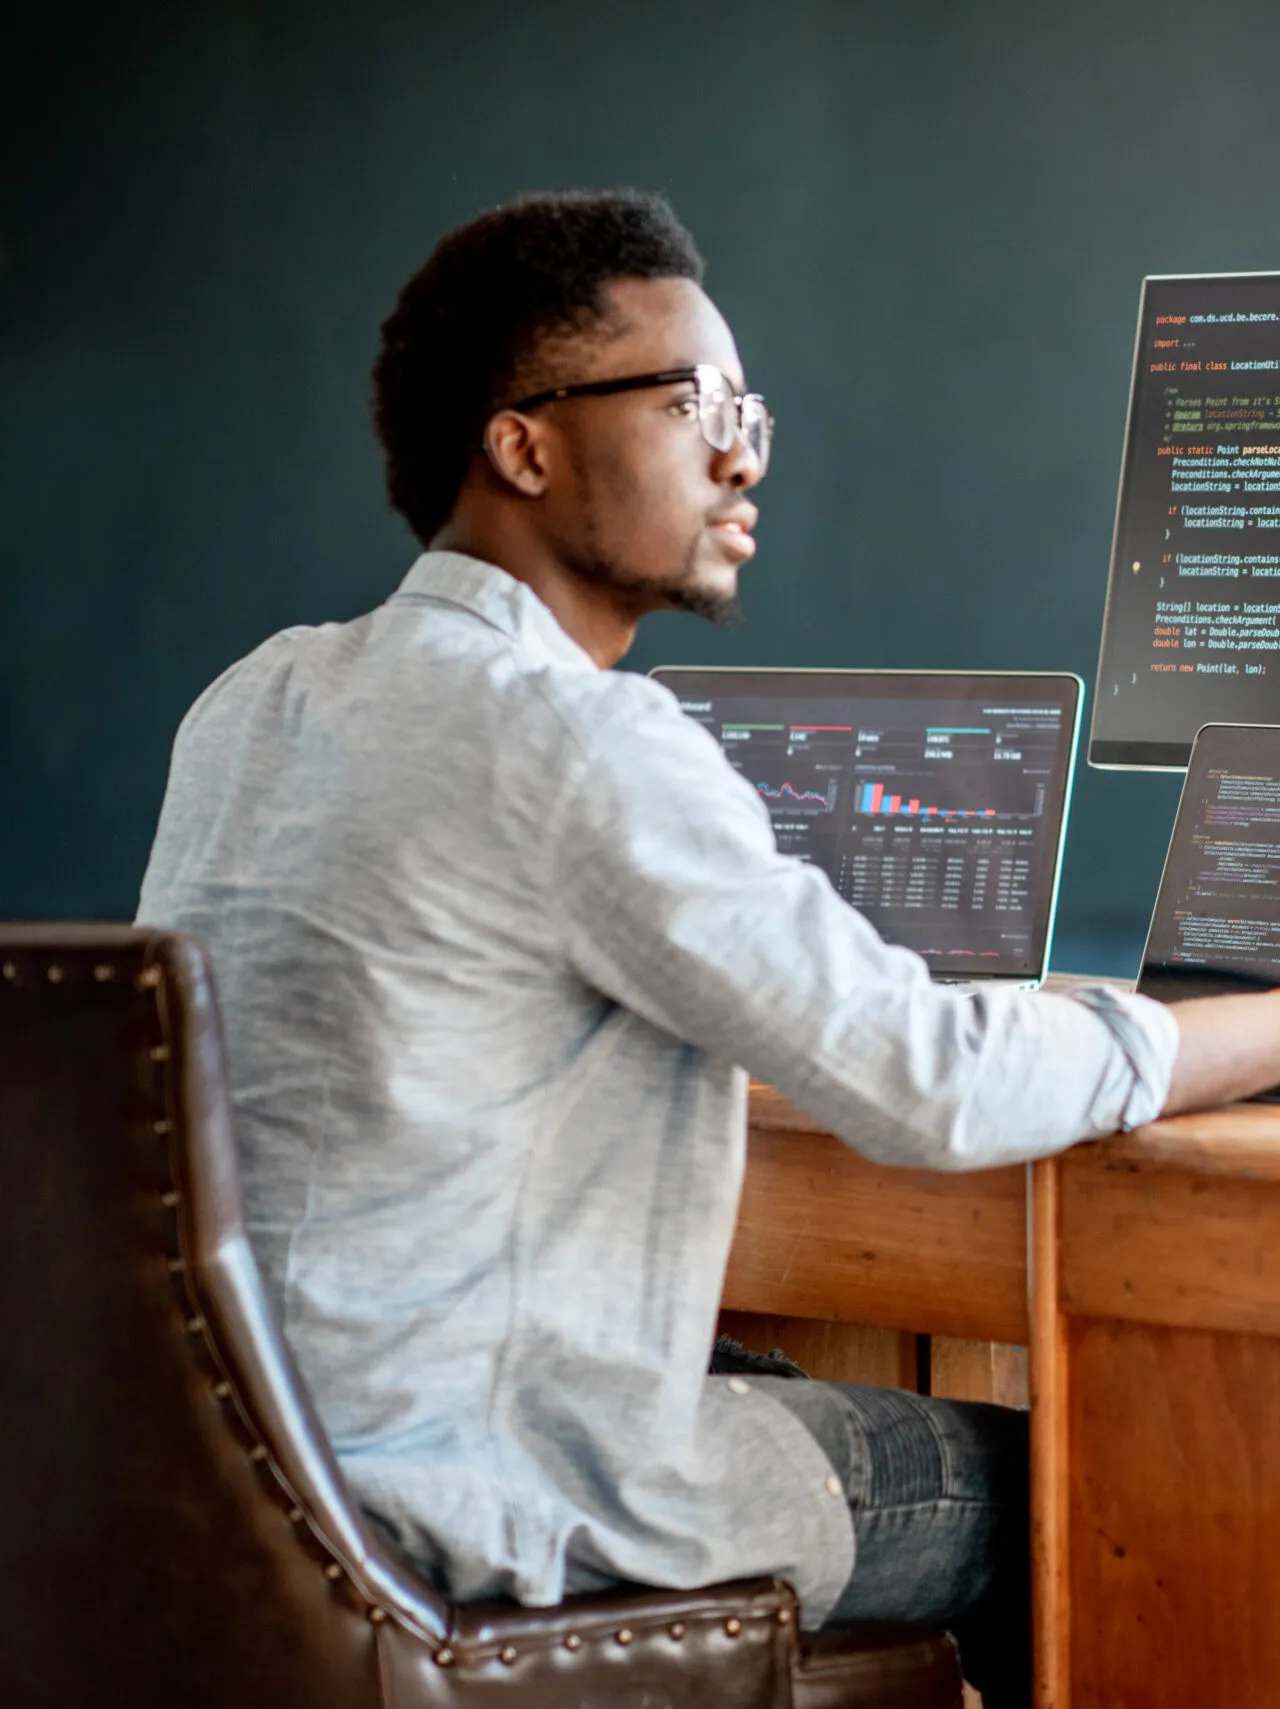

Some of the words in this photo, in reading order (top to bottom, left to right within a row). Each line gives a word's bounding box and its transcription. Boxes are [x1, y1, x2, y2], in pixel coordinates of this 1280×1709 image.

[1156, 315, 1186, 326] package
[1154, 339, 1179, 349] import
[1150, 361, 1176, 373] public
[1180, 361, 1201, 371] final
[1206, 361, 1227, 370] class
[1157, 446, 1184, 456] public
[1187, 446, 1213, 455] static
[1217, 445, 1239, 454] Point
[1171, 482, 1231, 493] locationString
[1168, 505, 1176, 515] if
[1184, 518, 1244, 529] locationString
[1163, 554, 1172, 563] if
[1179, 566, 1239, 578] locationString
[1196, 602, 1230, 612] location
[1154, 626, 1180, 636] double
[1185, 626, 1197, 636] lat
[1153, 639, 1179, 648] double
[1184, 639, 1196, 648] lon
[1151, 663, 1176, 672] return
[1180, 664, 1194, 672] new
[1197, 663, 1240, 675] Point(lat,
